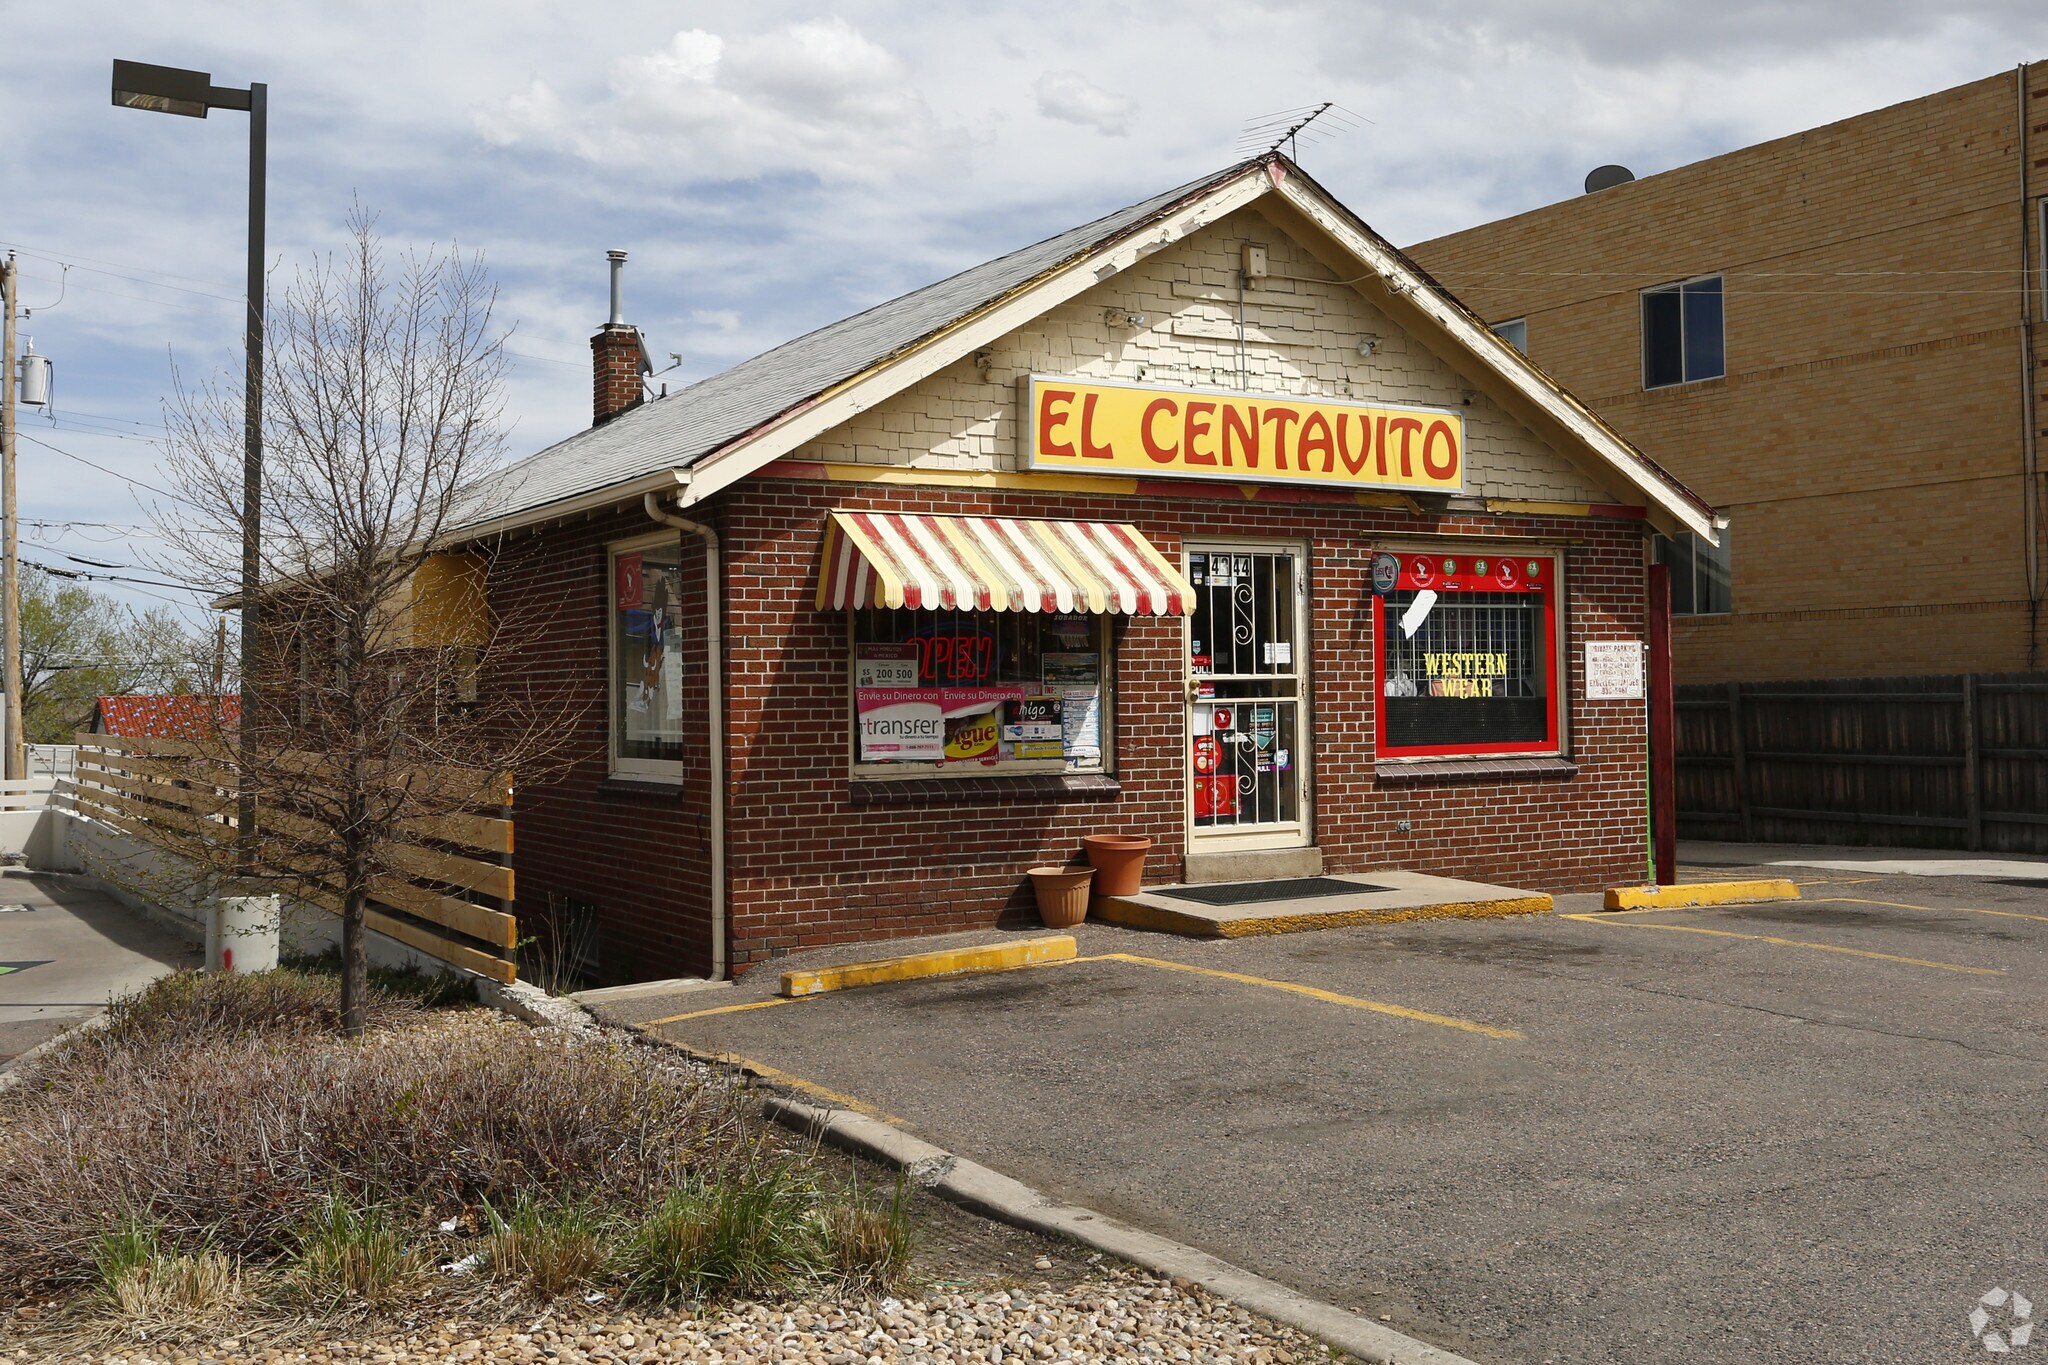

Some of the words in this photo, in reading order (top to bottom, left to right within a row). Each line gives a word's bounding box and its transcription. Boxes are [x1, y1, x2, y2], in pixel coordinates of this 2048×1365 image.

[1039, 389, 1114, 460] EL
[1140, 397, 1458, 481] CENTAVITO
[1423, 652, 1508, 676] WESTERN
[876, 669, 893, 679] 200
[896, 669, 913, 679] 500
[893, 691, 922, 700] Dinero
[978, 690, 1006, 700] Dinero
[1440, 678, 1493, 699] WEAR
